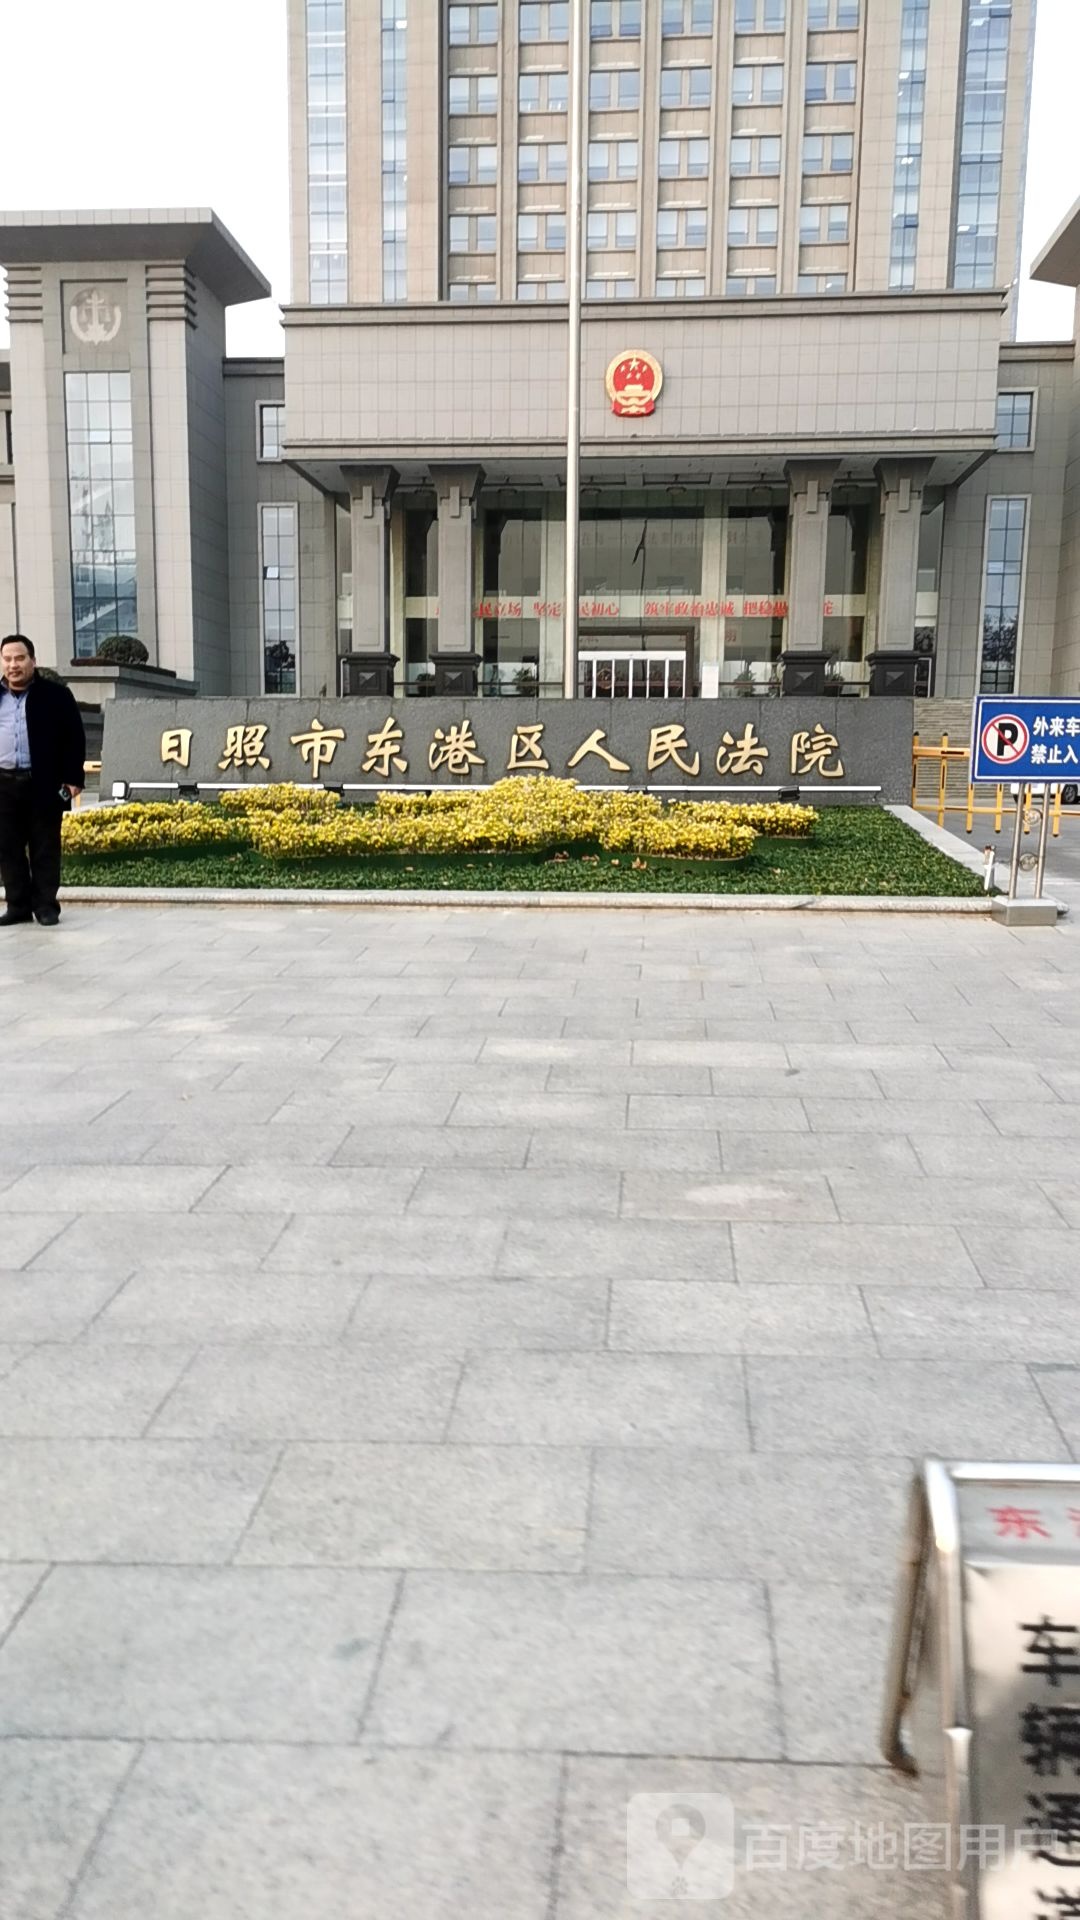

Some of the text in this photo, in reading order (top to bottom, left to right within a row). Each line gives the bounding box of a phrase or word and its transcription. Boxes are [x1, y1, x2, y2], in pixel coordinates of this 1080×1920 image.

[1033, 716, 1080, 737] 外来车
[159, 718, 844, 779] 日照市东港区人民法院
[1031, 744, 1079, 765] 禁止入
[1017, 1614, 1080, 1920] 车辆通
